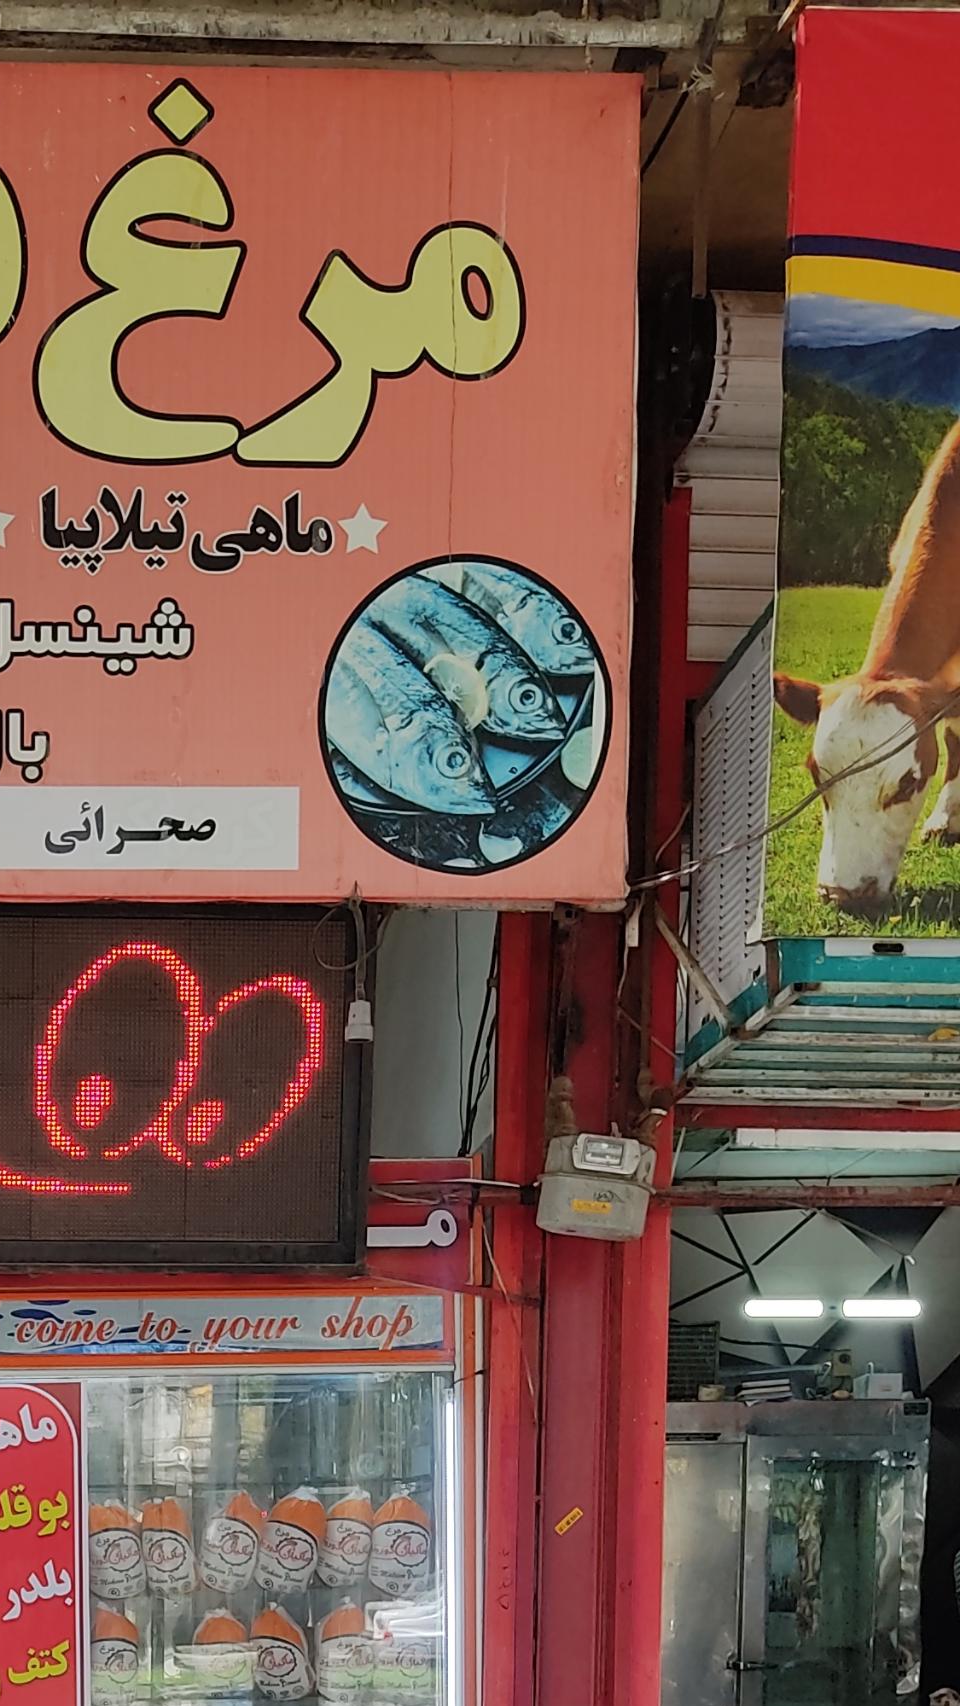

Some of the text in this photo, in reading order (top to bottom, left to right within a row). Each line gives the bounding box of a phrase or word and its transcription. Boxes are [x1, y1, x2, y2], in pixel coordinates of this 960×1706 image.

[33, 77, 526, 468] مرغ
[40, 486, 335, 574] ماهی تیلاپیا
[11, 1315, 119, 1346] come
[136, 1311, 182, 1344] to
[190, 1314, 302, 1354] your
[319, 1295, 421, 1352] shop
[11, 1640, 71, 1687] کتف
